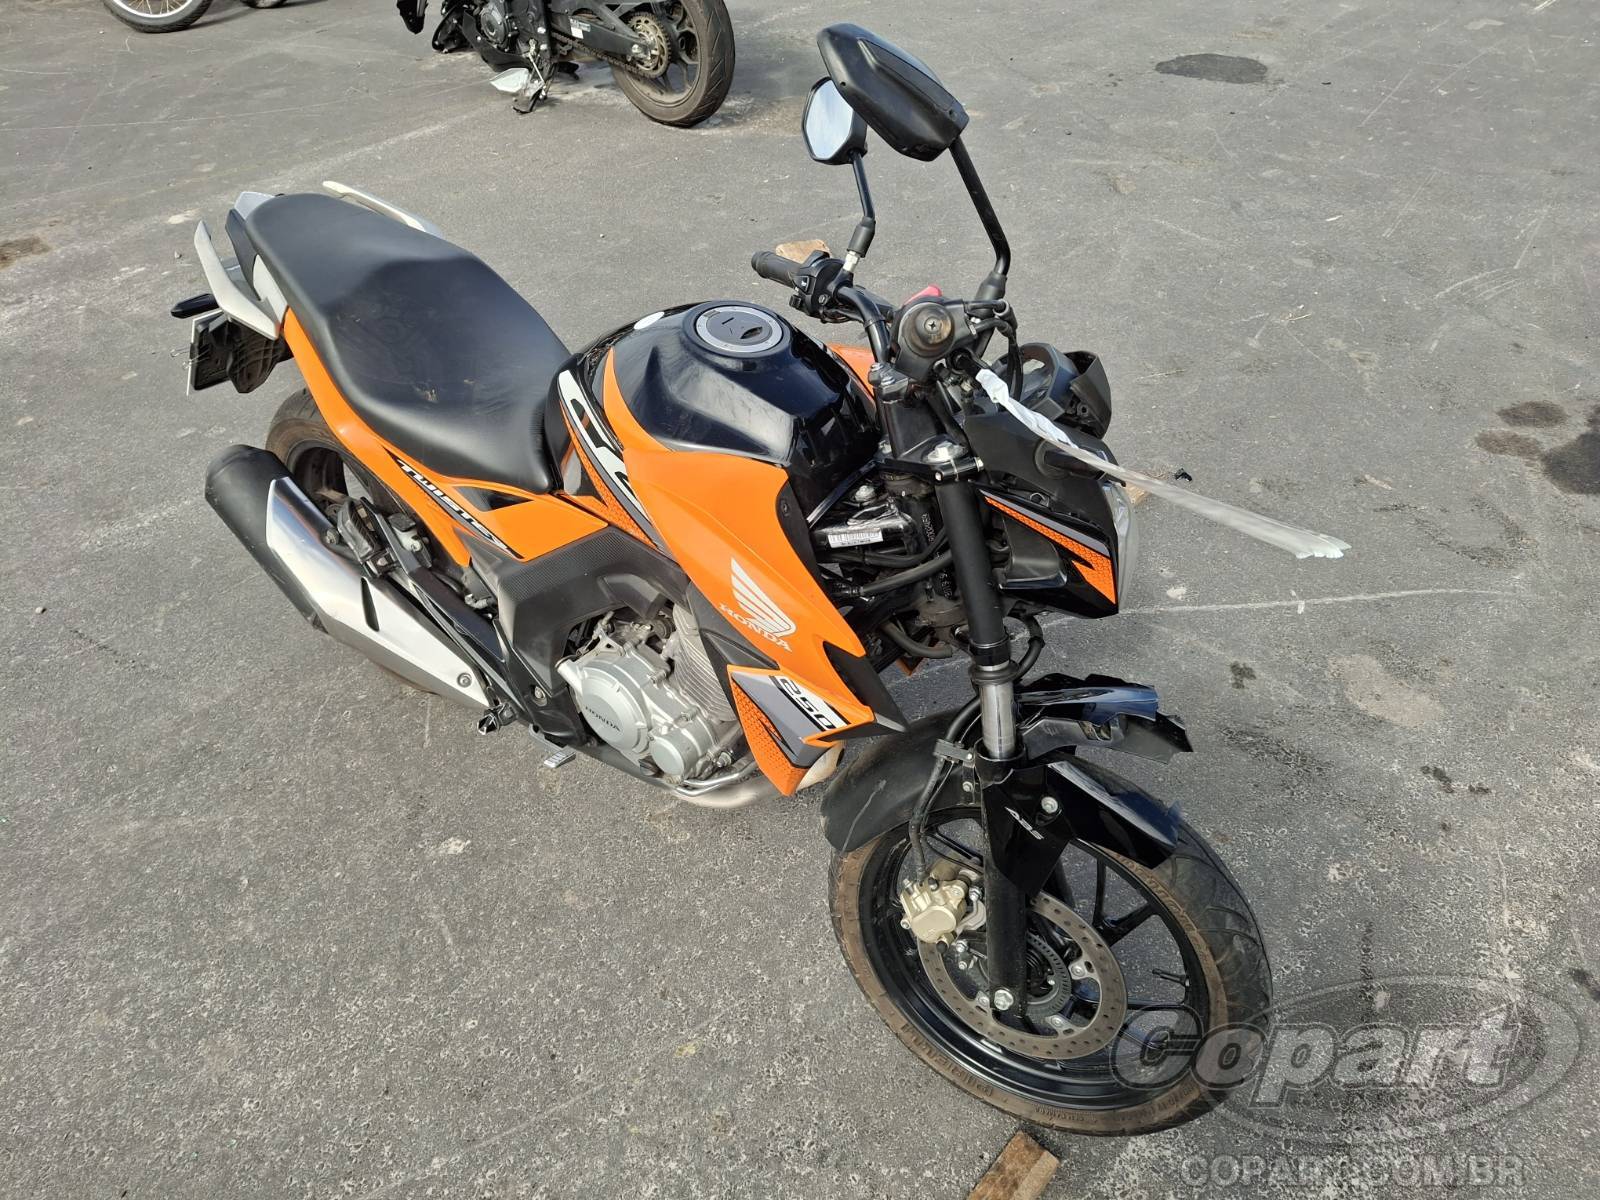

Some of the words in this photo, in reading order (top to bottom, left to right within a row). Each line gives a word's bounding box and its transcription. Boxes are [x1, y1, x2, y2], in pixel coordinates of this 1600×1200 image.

[396, 458, 518, 558] TWISTER
[719, 602, 793, 653] HONDA
[585, 705, 621, 733] HONDA
[780, 676, 837, 729] 250
[1004, 806, 1045, 840] ABS
